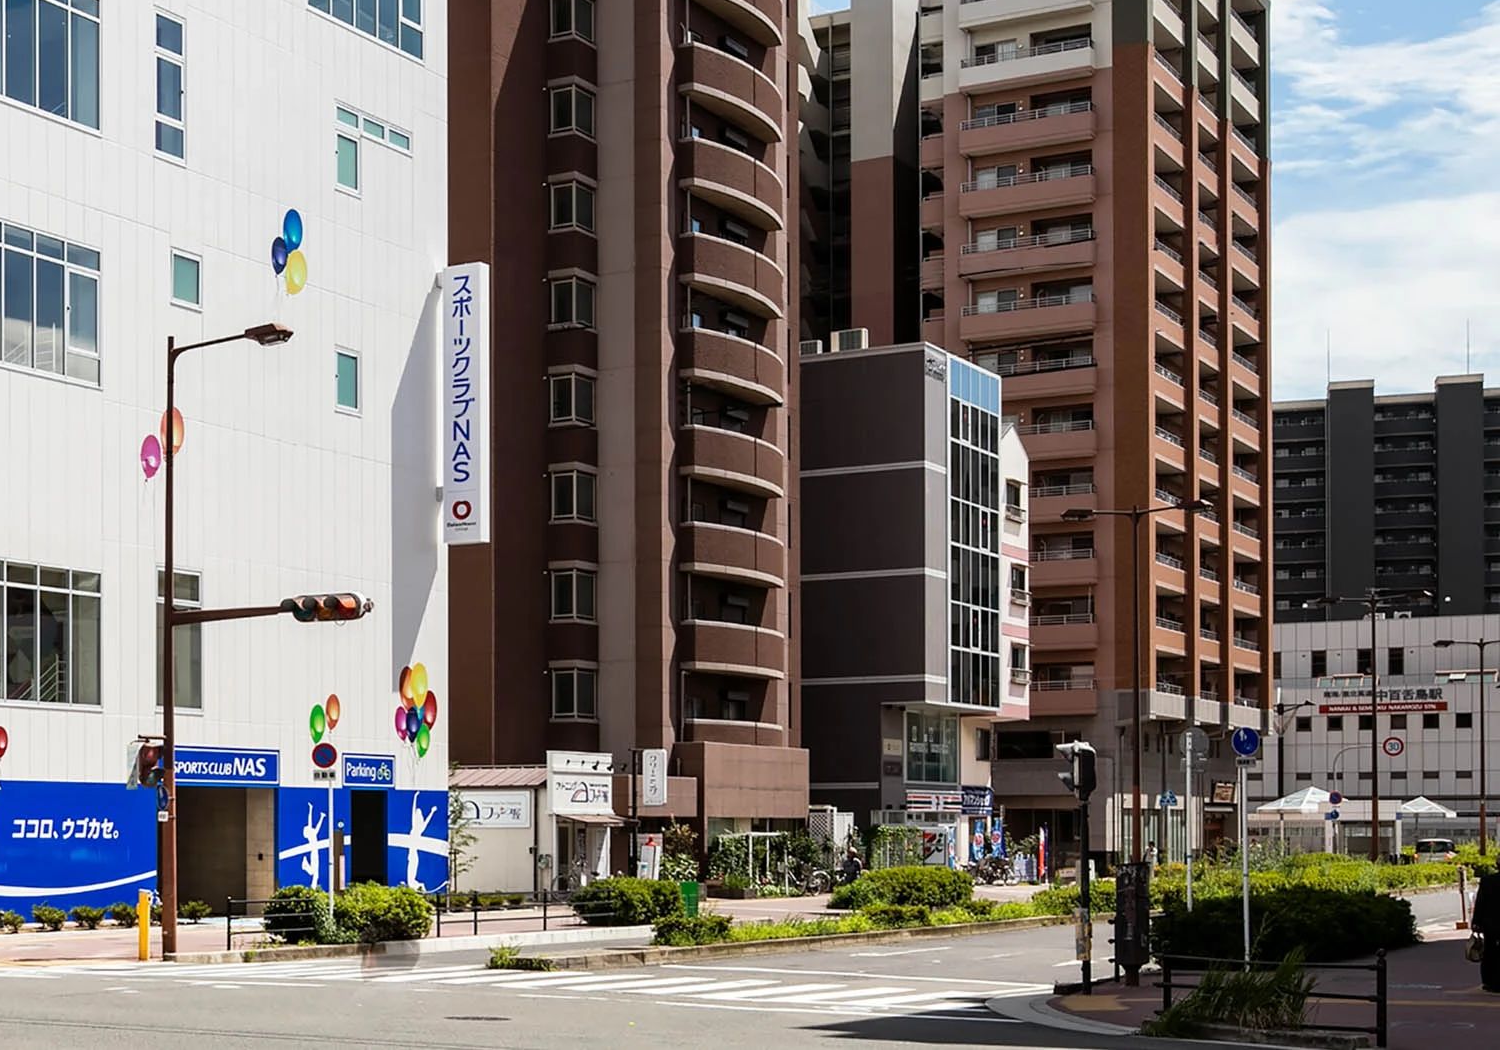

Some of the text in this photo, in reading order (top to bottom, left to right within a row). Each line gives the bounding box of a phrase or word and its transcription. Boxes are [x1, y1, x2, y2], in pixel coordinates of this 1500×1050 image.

[452, 275, 475, 483] スポーツクラブNAS
[1387, 742, 1400, 751] 30
[174, 757, 267, 777] SPORTS CLUB NAS
[346, 762, 377, 782] Parking
[11, 817, 120, 840] ココロ、ウゴカセ。
